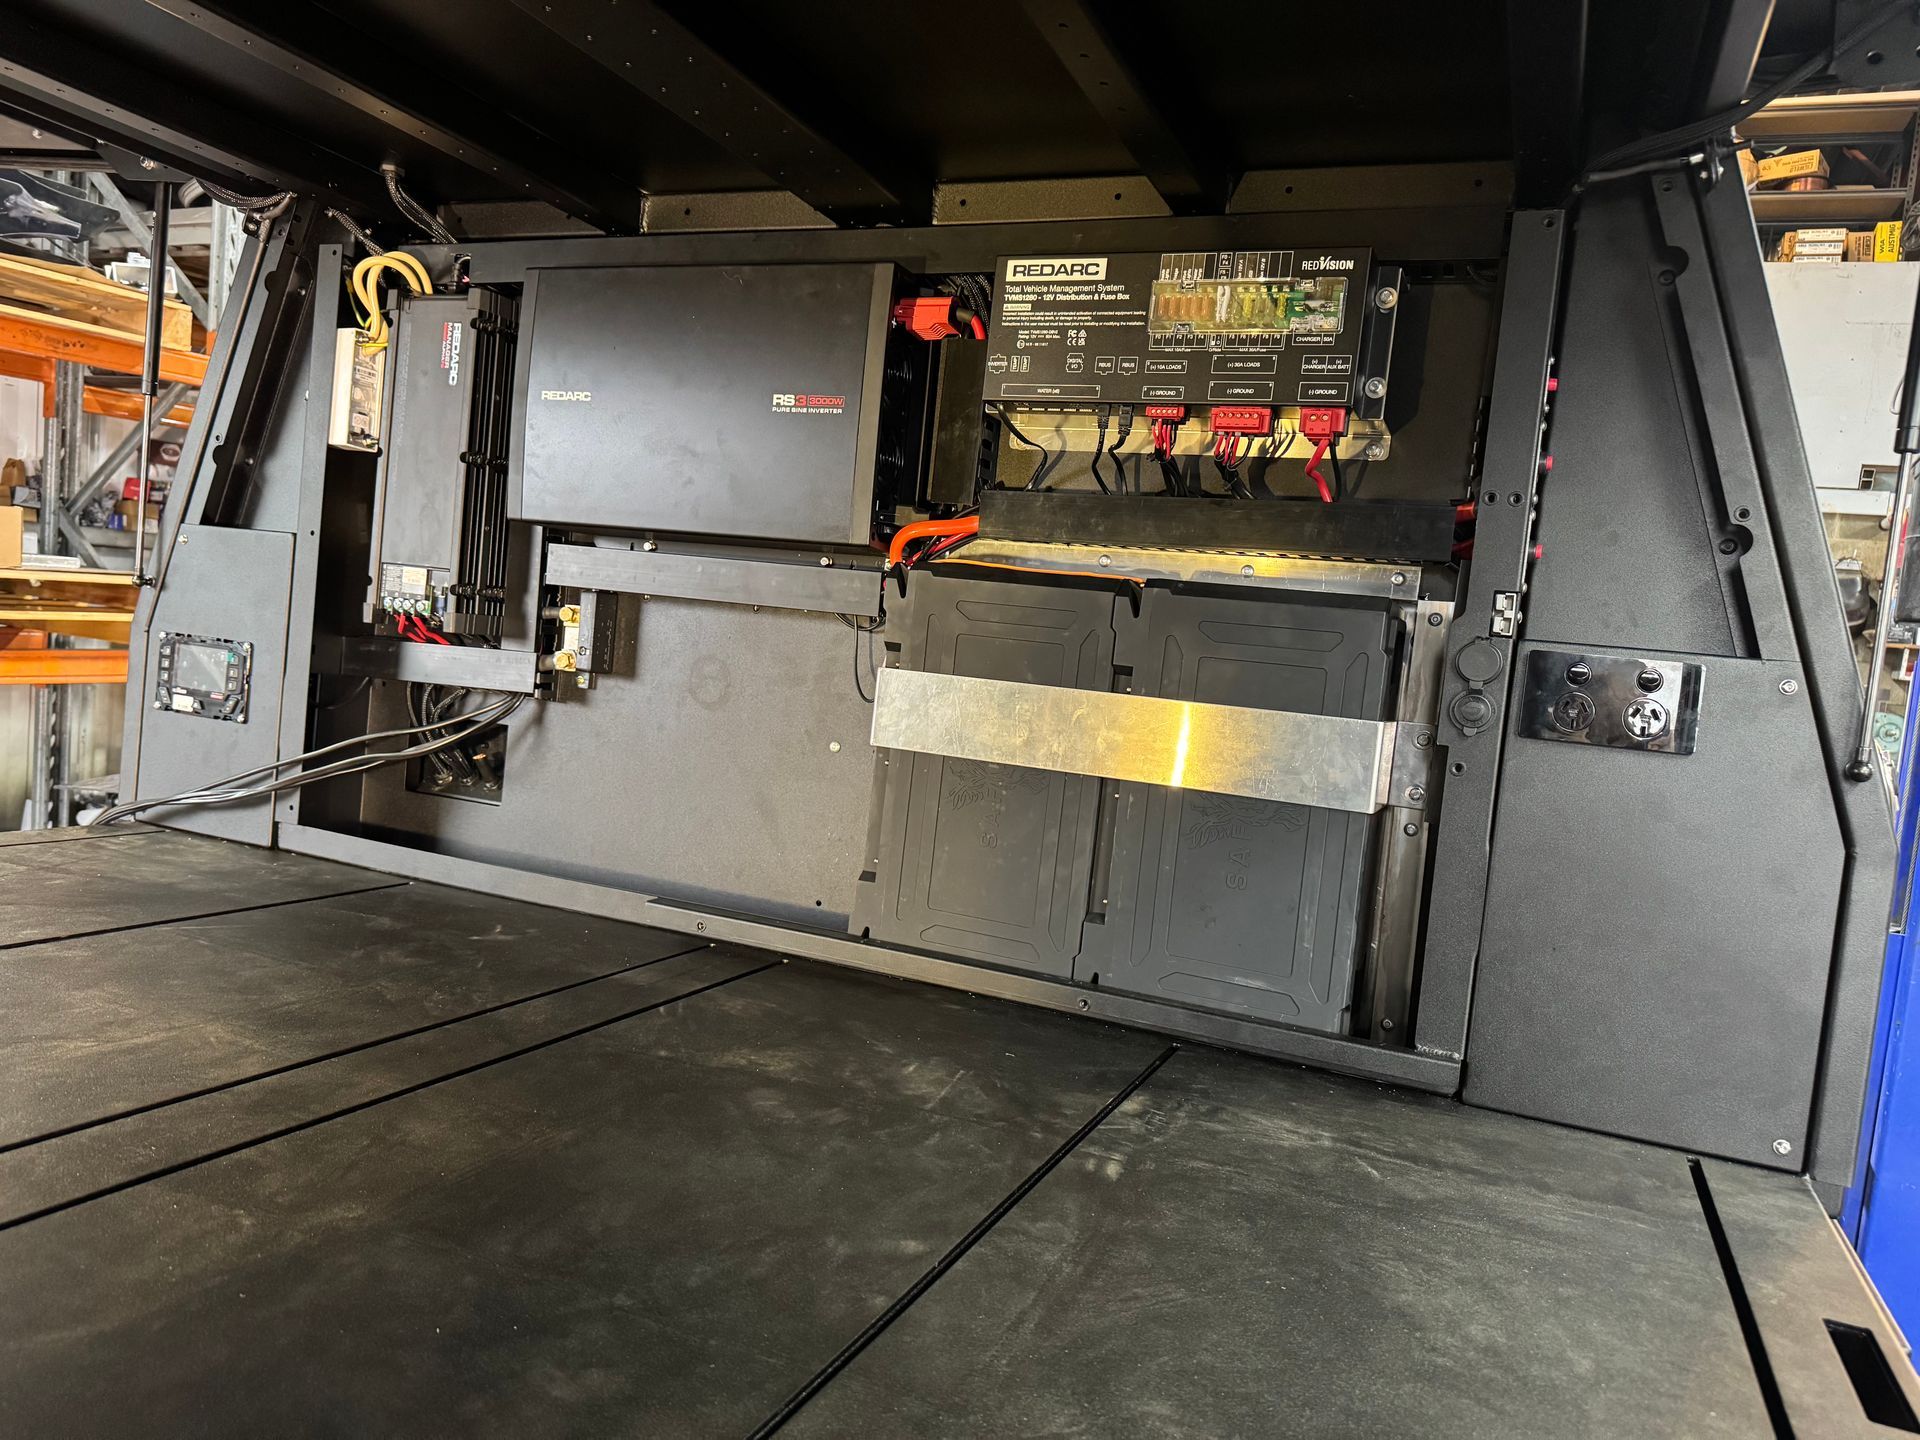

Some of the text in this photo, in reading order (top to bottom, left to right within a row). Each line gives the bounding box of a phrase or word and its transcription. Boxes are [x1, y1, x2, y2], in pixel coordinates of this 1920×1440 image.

[1012, 263, 1100, 277] REDARC
[1005, 284, 1125, 293] Total Vehicle Management System
[449, 323, 461, 385] REDARC
[542, 391, 592, 401] REDARC
[773, 394, 806, 406] RS3
